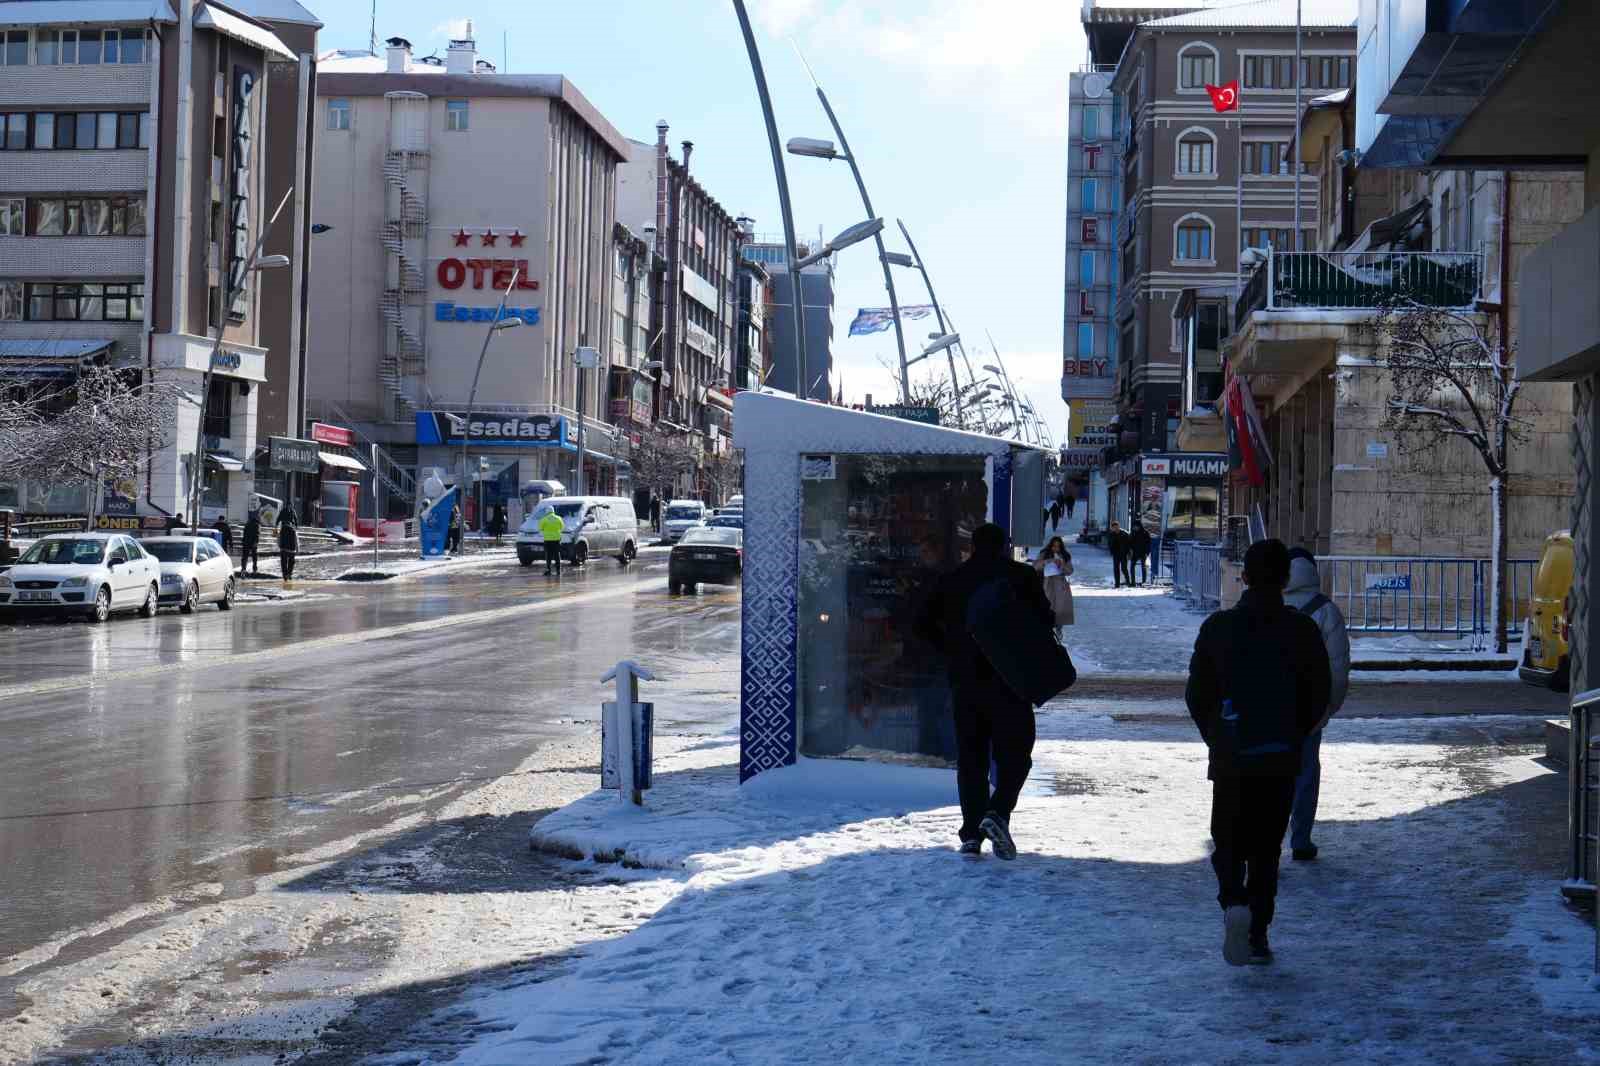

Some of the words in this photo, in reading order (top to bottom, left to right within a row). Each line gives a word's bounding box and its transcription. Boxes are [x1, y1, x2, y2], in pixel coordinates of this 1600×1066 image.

[437, 257, 539, 291] OTEL
[1064, 358, 1106, 377] BEY
[451, 418, 552, 441] Esadaş
